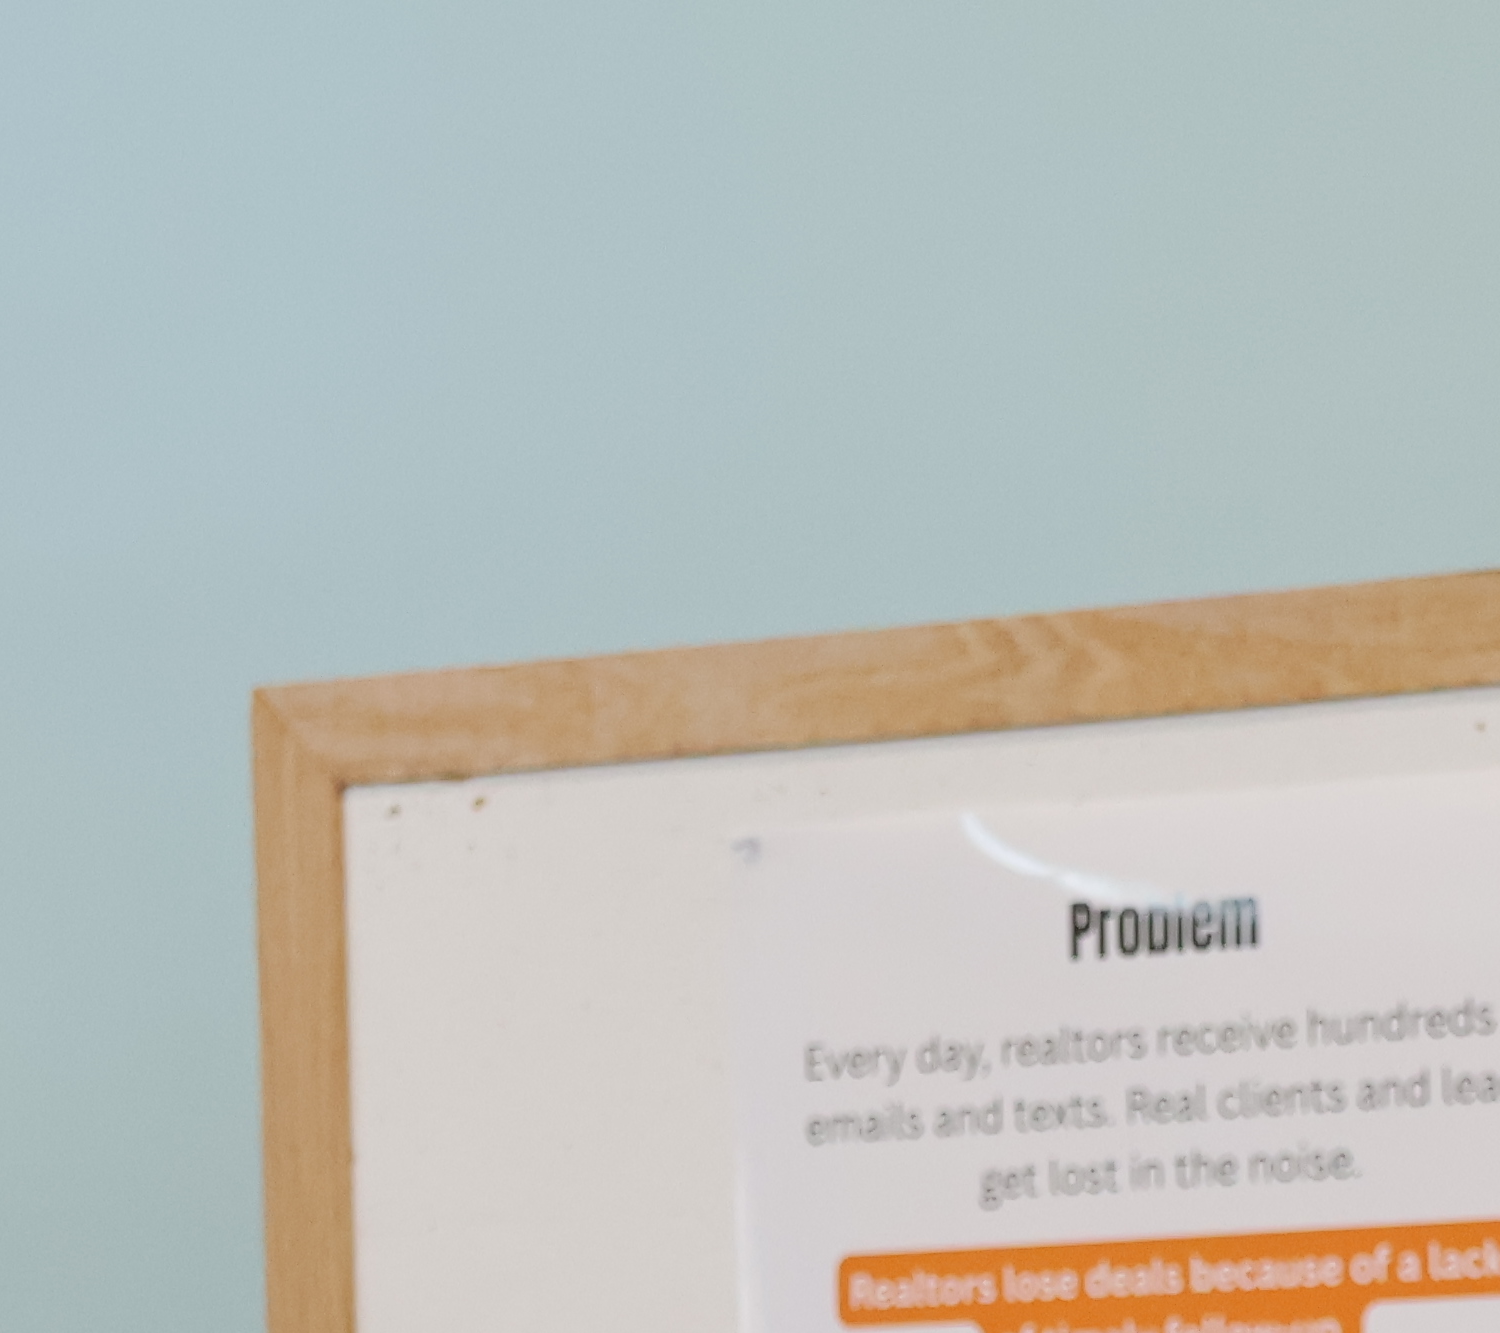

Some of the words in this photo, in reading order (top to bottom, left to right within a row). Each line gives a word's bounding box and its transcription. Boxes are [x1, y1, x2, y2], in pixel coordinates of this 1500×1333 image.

[805, 1042, 906, 1085] Every
[915, 1034, 991, 1080] day,
[1001, 1027, 1147, 1067] realtors
[1157, 1015, 1297, 1058] receive
[1307, 1001, 1495, 1048] hundreds
[806, 1103, 923, 1147] emails
[934, 1101, 1002, 1139] and
[1014, 1093, 1110, 1132] texts.
[1126, 1084, 1206, 1127] Real
[1217, 1075, 1344, 1122] clients
[1356, 1071, 1430, 1111] and
[980, 1163, 1038, 1209] get
[1048, 1155, 1120, 1197] lost
[1130, 1152, 1164, 1192] in
[1175, 1148, 1239, 1189] the
[1247, 1144, 1362, 1186] noise.
[848, 1265, 995, 1309] Realtors
[1005, 1257, 1079, 1302] lose
[1087, 1253, 1180, 1297] deals
[1191, 1245, 1342, 1292] because
[1351, 1242, 1394, 1283] of
[1398, 1248, 1420, 1280] a
